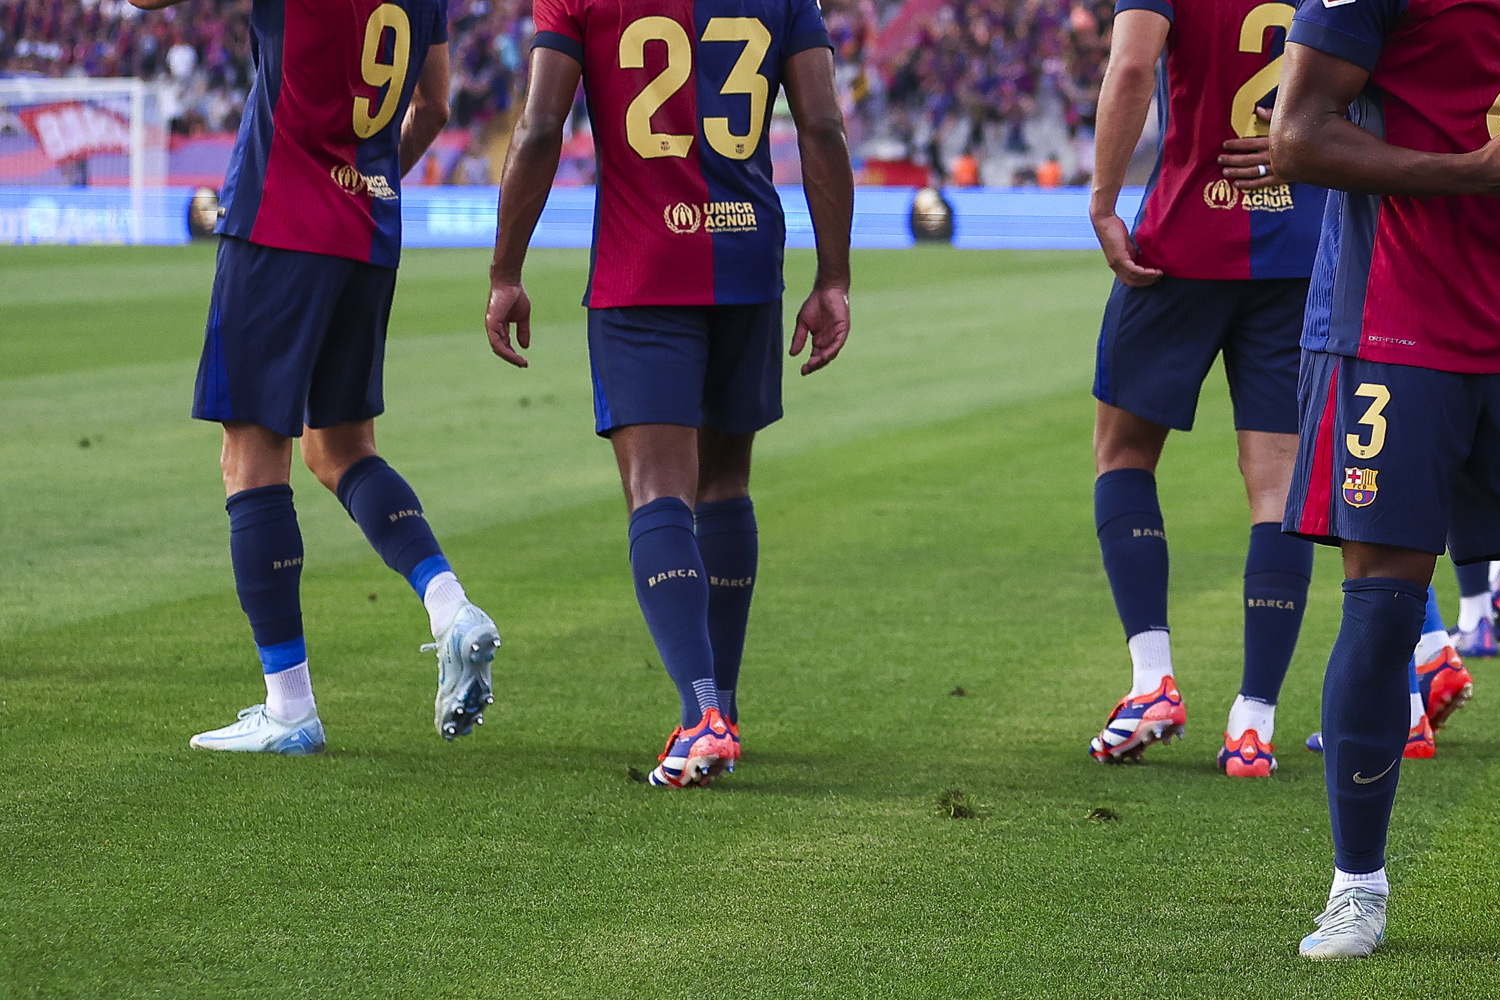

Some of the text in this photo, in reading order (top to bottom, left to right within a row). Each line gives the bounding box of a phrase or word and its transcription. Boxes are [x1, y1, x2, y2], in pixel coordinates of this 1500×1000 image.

[352, 3, 411, 139] 9
[619, 15, 772, 160] 23
[1231, 2, 1297, 138] 2
[703, 202, 754, 215] UNHCR
[704, 214, 757, 228] ACNUR
[1241, 194, 1293, 207] ACNUR
[1346, 383, 1391, 459] 3
